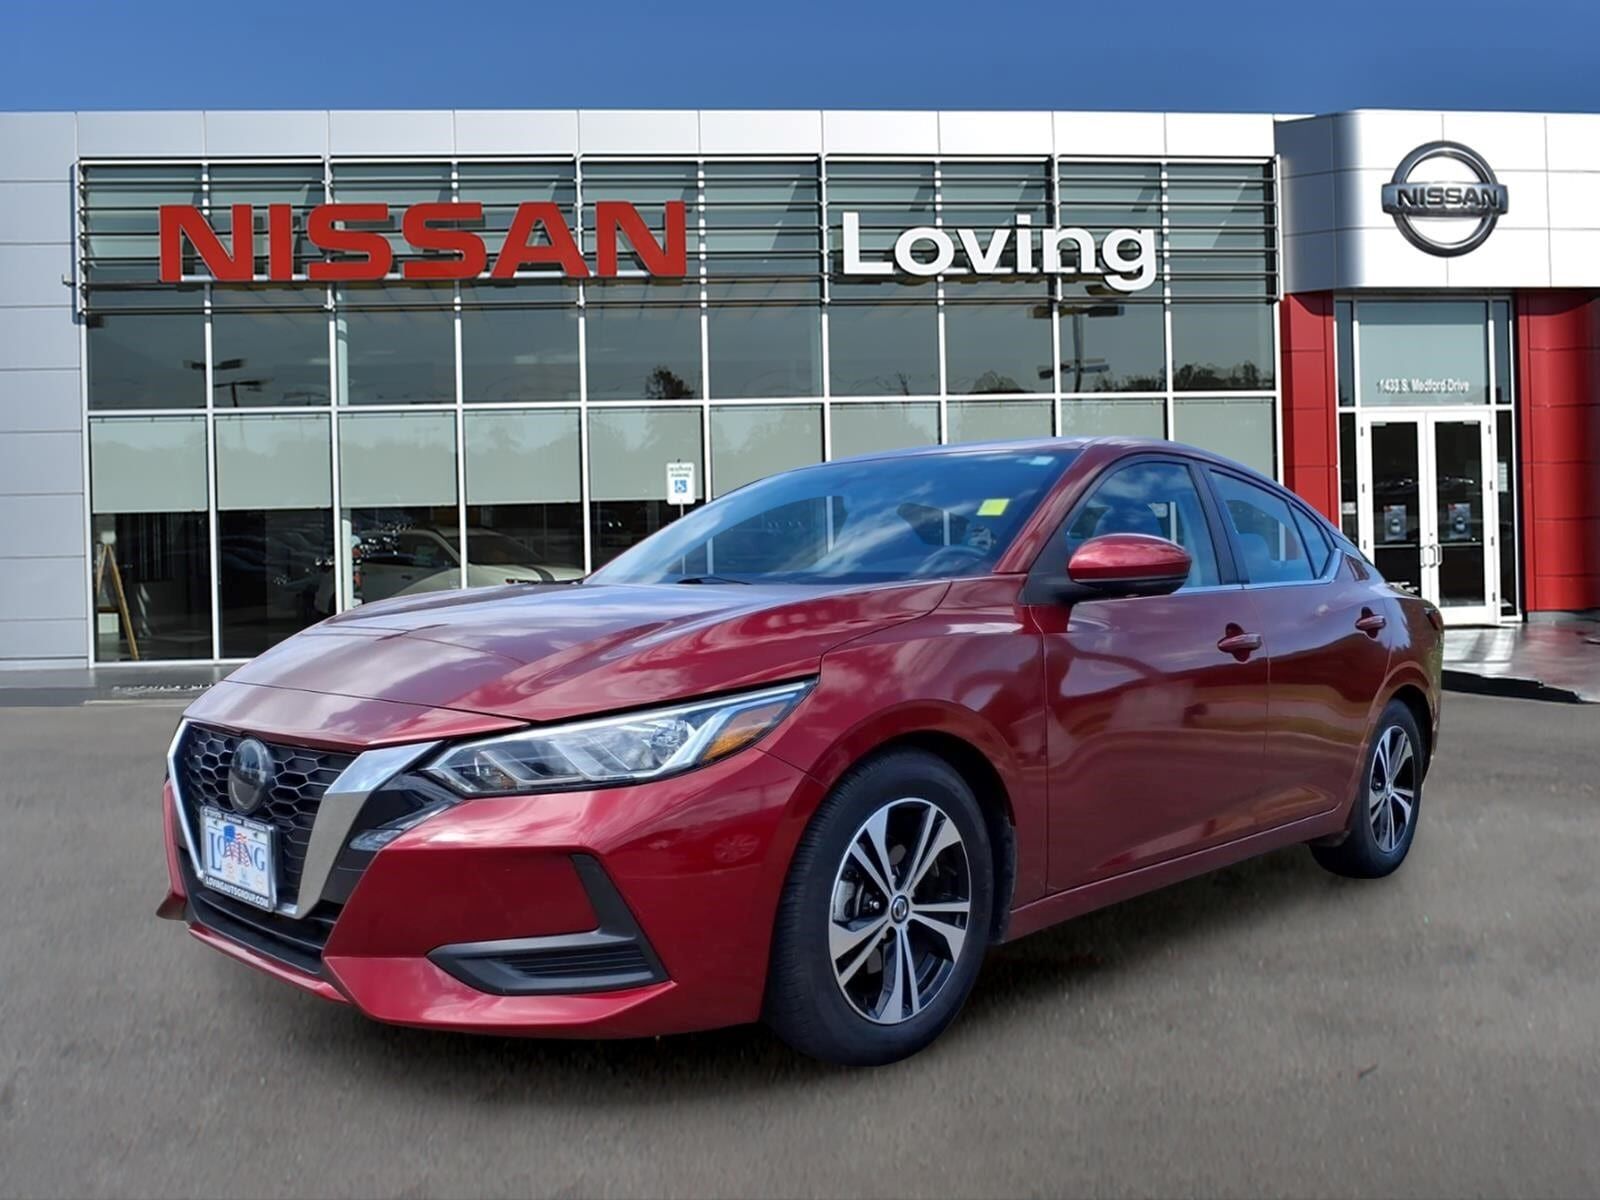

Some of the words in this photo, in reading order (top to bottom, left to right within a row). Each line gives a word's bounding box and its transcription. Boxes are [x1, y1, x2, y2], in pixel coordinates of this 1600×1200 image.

[1397, 187, 1498, 206] NISSAN
[159, 201, 687, 283] NISSAN
[842, 211, 1158, 292] Loving
[1447, 378, 1469, 393] Drive
